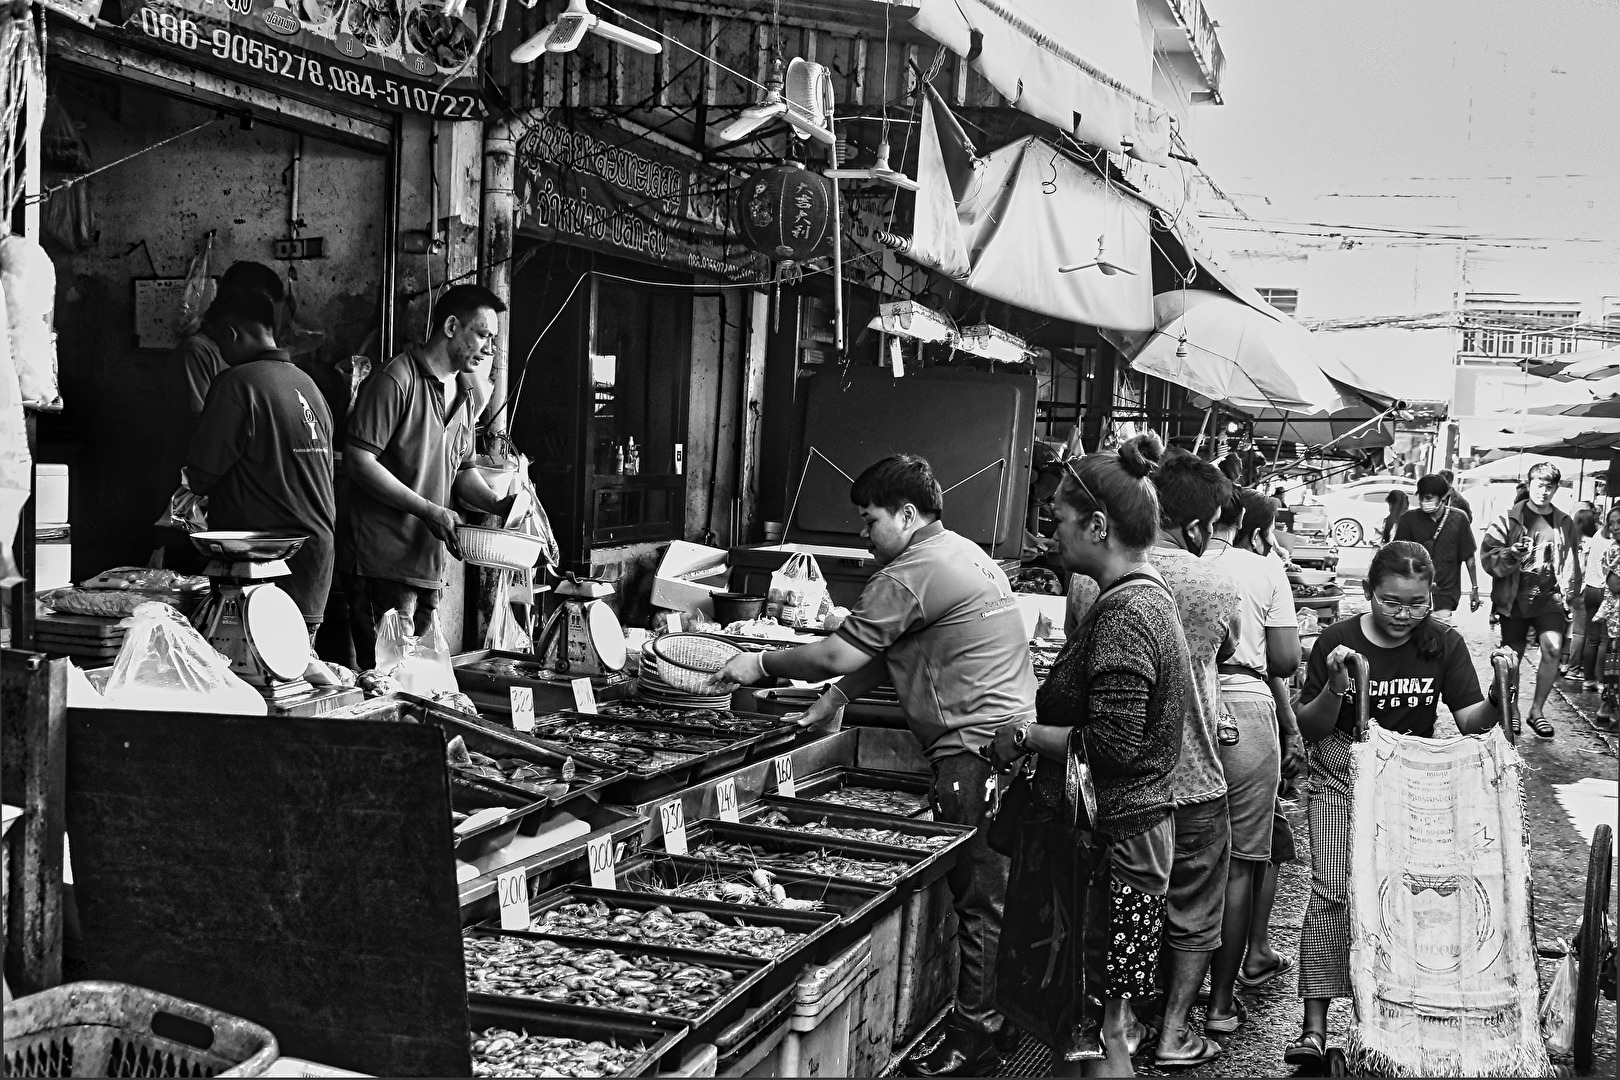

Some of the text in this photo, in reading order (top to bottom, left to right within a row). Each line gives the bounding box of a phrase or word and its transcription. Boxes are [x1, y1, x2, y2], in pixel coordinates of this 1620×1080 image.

[777, 757, 792, 784] 160
[717, 783, 736, 813] 240
[662, 803, 684, 835] 230
[590, 839, 613, 874] 200
[500, 874, 527, 909] 200
